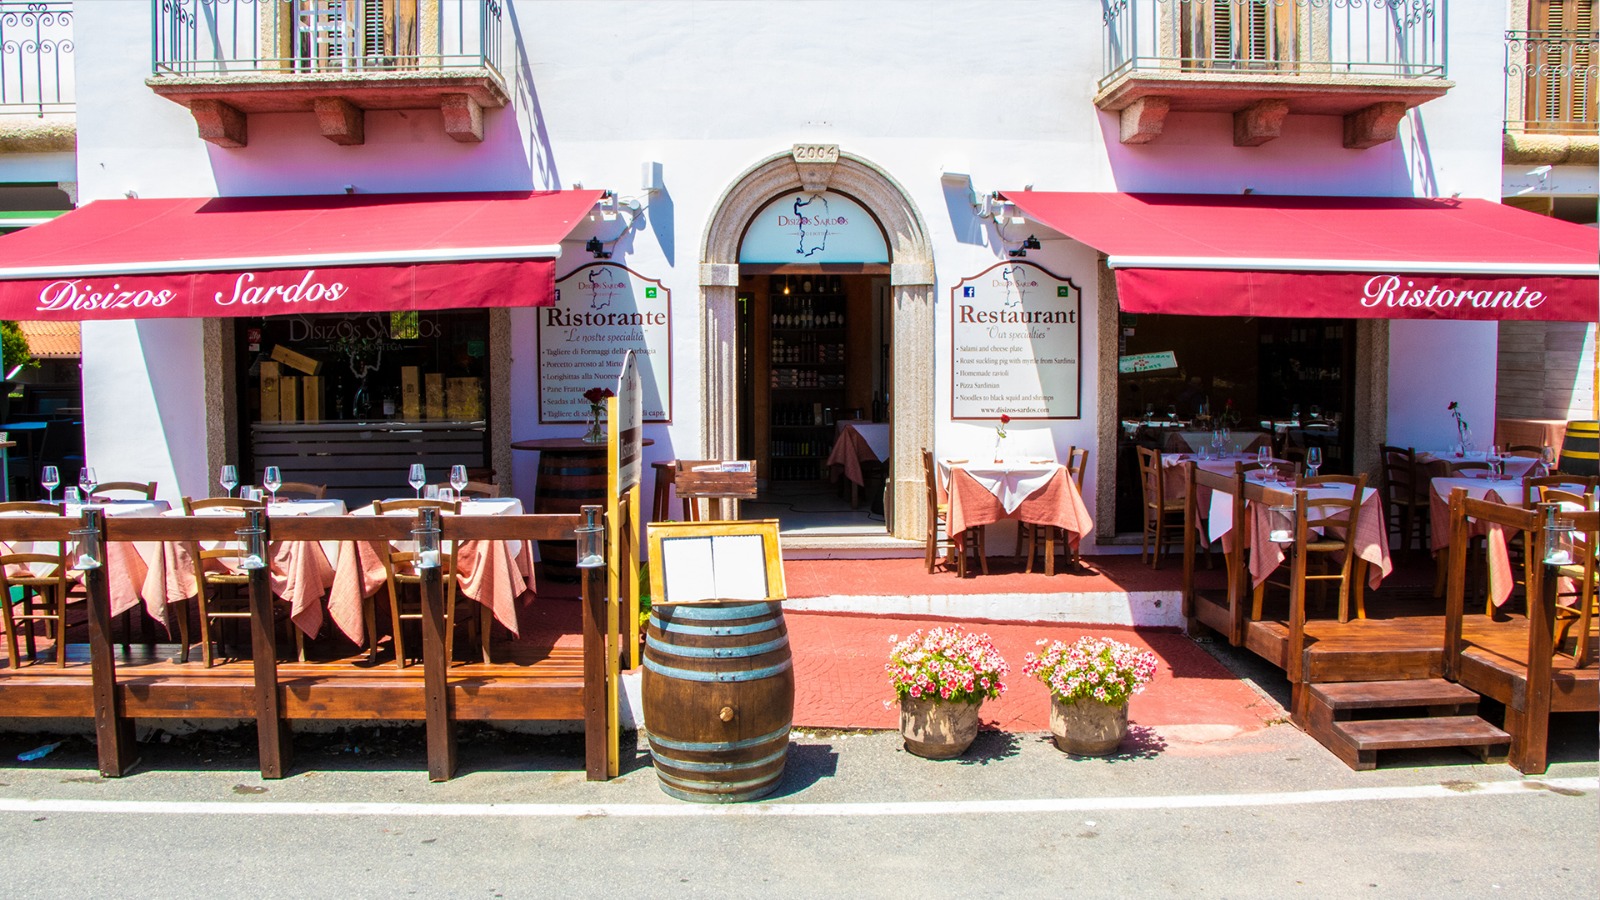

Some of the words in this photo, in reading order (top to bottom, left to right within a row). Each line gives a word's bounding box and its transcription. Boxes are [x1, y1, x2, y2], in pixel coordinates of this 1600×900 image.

[796, 146, 835, 158] 2004
[36, 279, 178, 311] Disizos
[214, 270, 349, 306] Sardos
[1360, 275, 1548, 309] Ristorante
[546, 308, 666, 327] Ristorante
[959, 304, 1076, 324] Restaurant
[582, 330, 605, 342] nostre
[546, 348, 571, 357] Tagliere
[580, 348, 609, 356] Formaggi
[611, 347, 627, 355] della
[1010, 345, 1023, 353] plate
[1005, 394, 1020, 402] squid
[547, 410, 573, 419] Tagliere
[980, 406, 1050, 414] www.disizos-sardos.com
